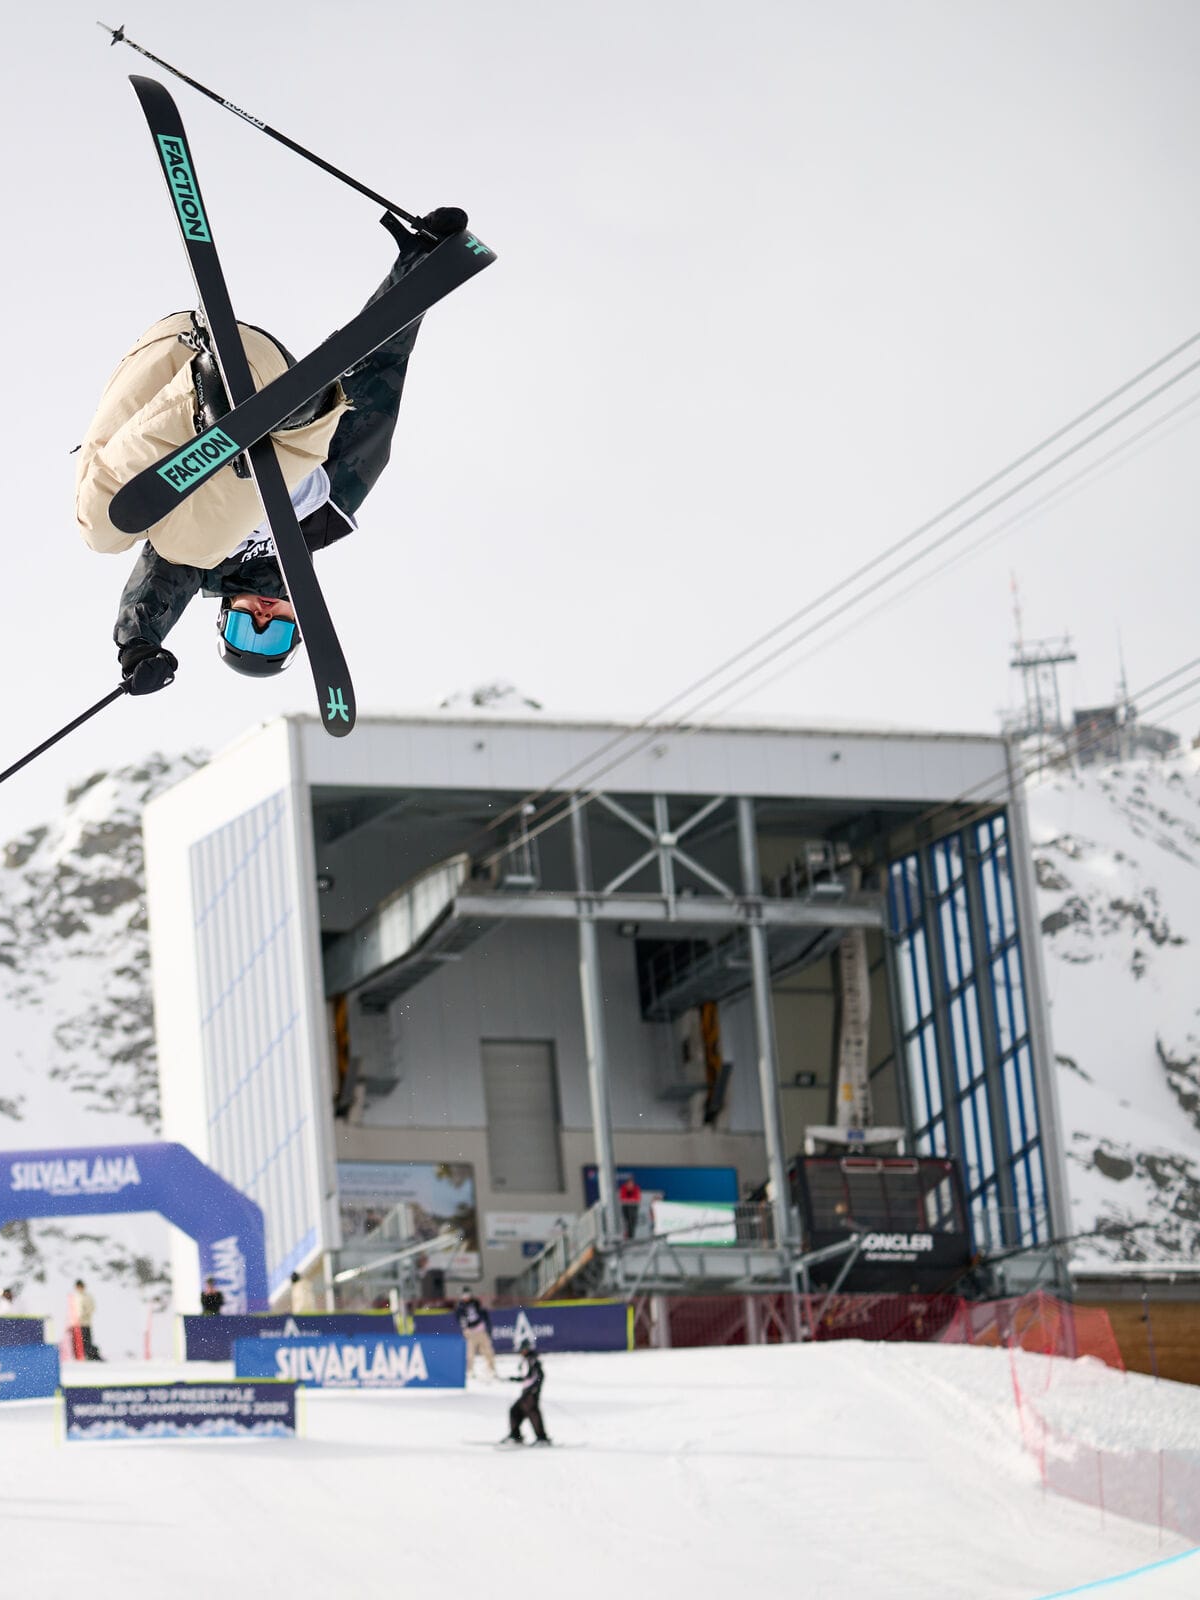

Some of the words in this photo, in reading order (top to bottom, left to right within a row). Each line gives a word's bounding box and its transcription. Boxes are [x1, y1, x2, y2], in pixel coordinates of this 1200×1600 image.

[163, 139, 206, 237] FACTION
[163, 432, 234, 487] FACTION
[10, 1155, 141, 1191] SILVAPLANA
[275, 1342, 428, 1381] SILVAPLANA
